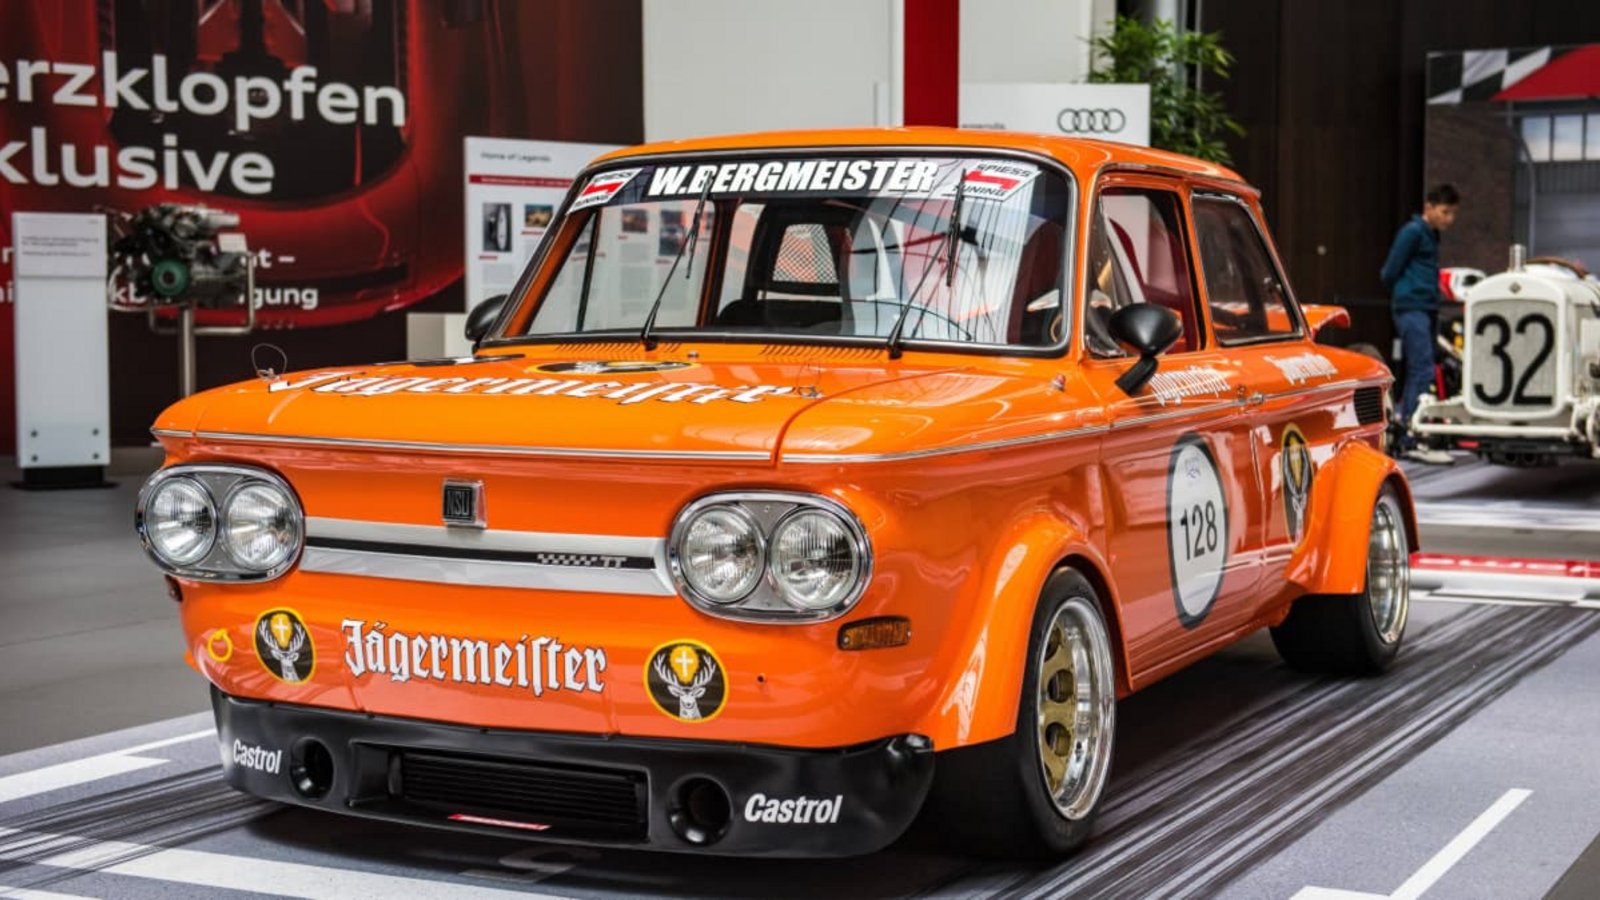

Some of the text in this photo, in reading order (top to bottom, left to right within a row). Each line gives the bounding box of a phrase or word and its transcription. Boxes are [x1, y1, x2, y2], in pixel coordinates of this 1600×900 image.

[0, 51, 406, 131] rzklopfen
[648, 160, 938, 196] W.BERGMEISTER
[976, 163, 1032, 178] SPIESS
[1473, 313, 1555, 406] 32
[1180, 500, 1218, 562] 128
[600, 555, 627, 569] TT
[341, 617, 607, 697] Jägermeister
[232, 738, 282, 774] Castrol
[744, 793, 843, 824] Castrol
